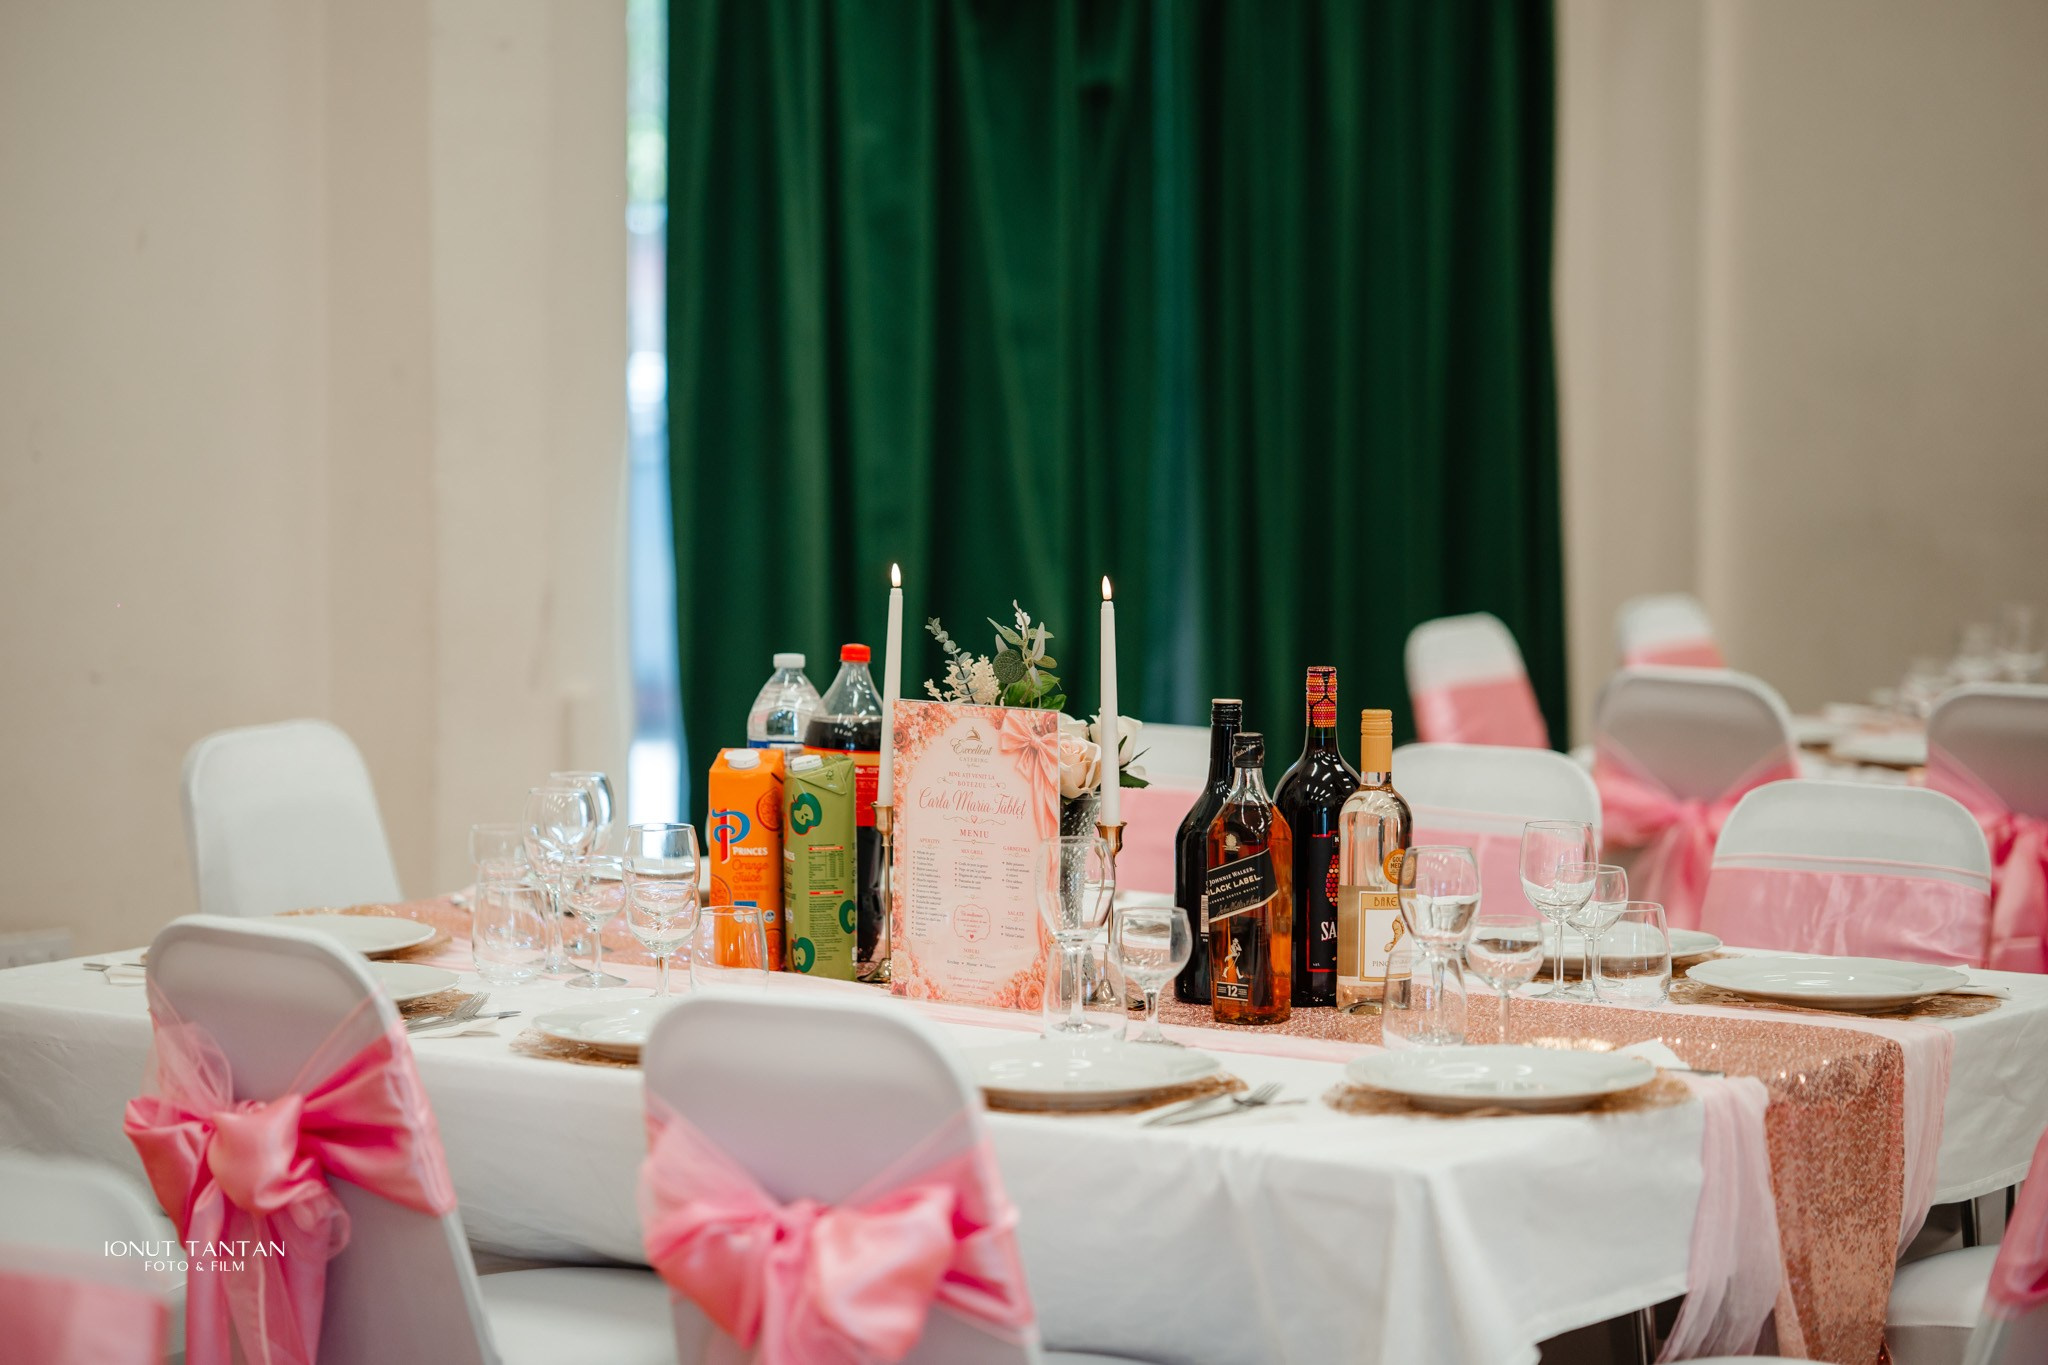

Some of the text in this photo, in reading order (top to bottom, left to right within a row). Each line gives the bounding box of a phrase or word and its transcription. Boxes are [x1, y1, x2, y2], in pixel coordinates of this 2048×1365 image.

[919, 786, 950, 810] Carla
[952, 789, 990, 813] Maria
[960, 828, 989, 839] MENIU
[732, 846, 768, 856] PRINCES
[732, 860, 770, 873] Orange
[732, 871, 763, 883] Juice
[1209, 867, 1254, 887] JOHNNIE WALKER
[1233, 874, 1261, 888] LABEL
[1374, 896, 1399, 907] BARE
[1321, 921, 1338, 941] SA
[1227, 985, 1238, 997] 12
